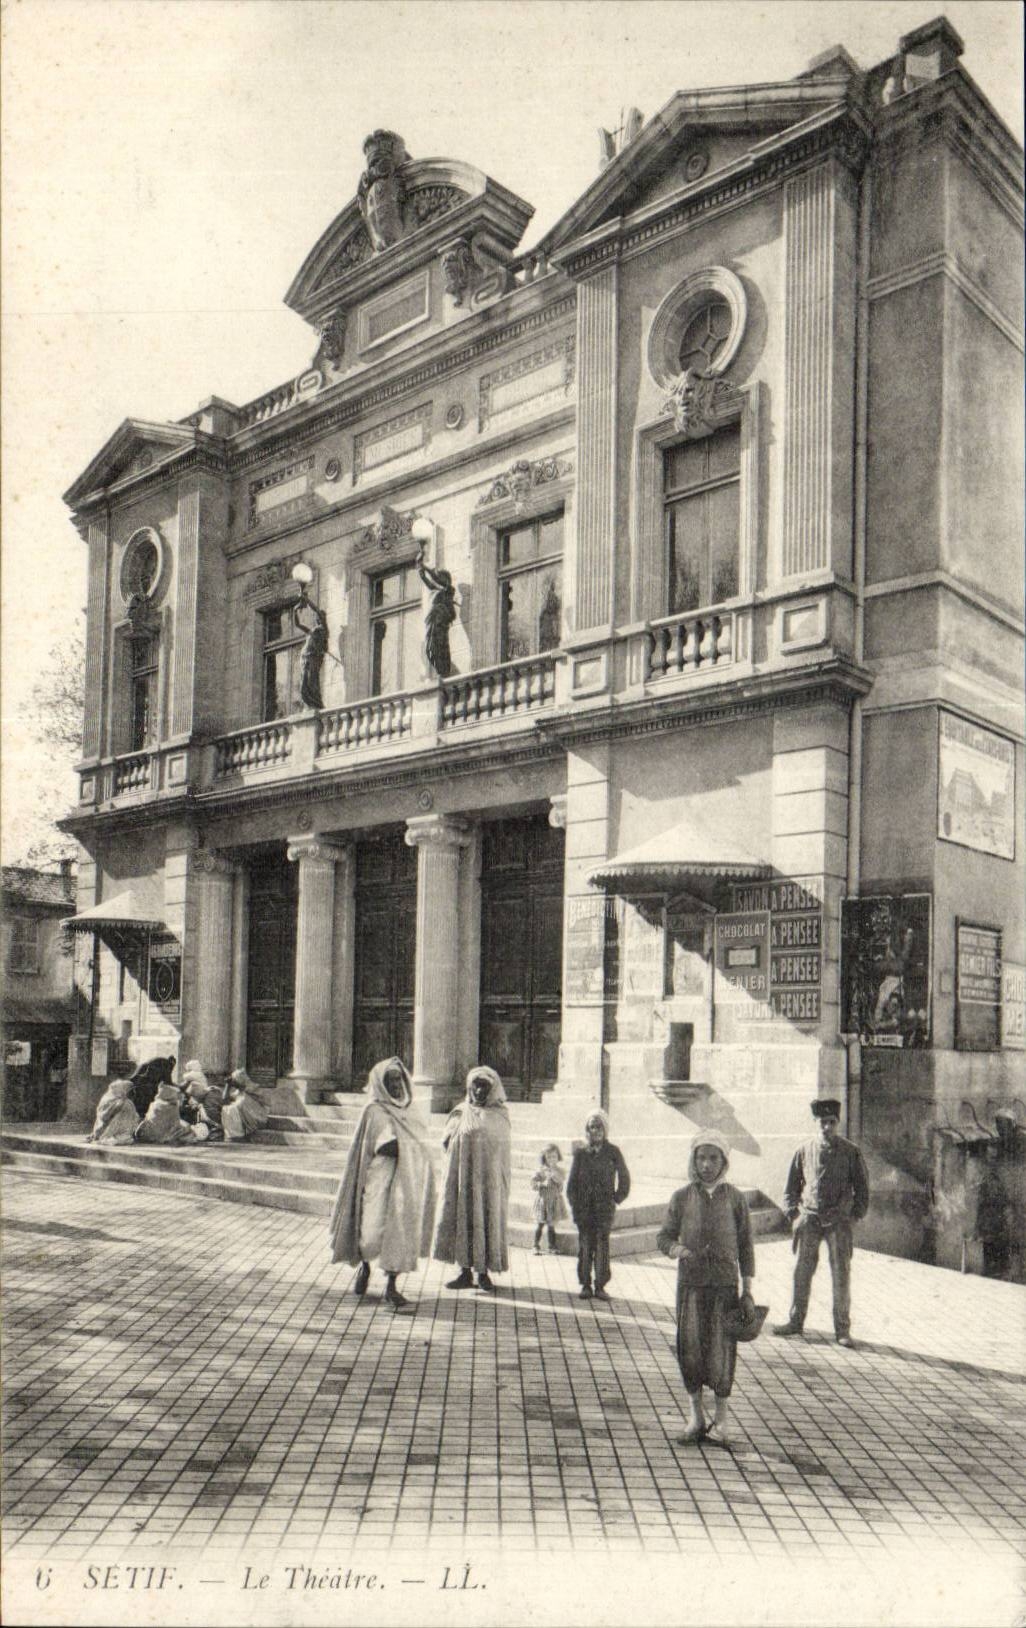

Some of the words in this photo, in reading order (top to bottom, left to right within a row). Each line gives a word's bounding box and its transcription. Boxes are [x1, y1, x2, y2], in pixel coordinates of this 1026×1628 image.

[719, 923, 765, 938] CHOCOLAT
[781, 920, 818, 945] PENSEE
[781, 956, 818, 981] PENSEE
[719, 975, 765, 990] ENIER
